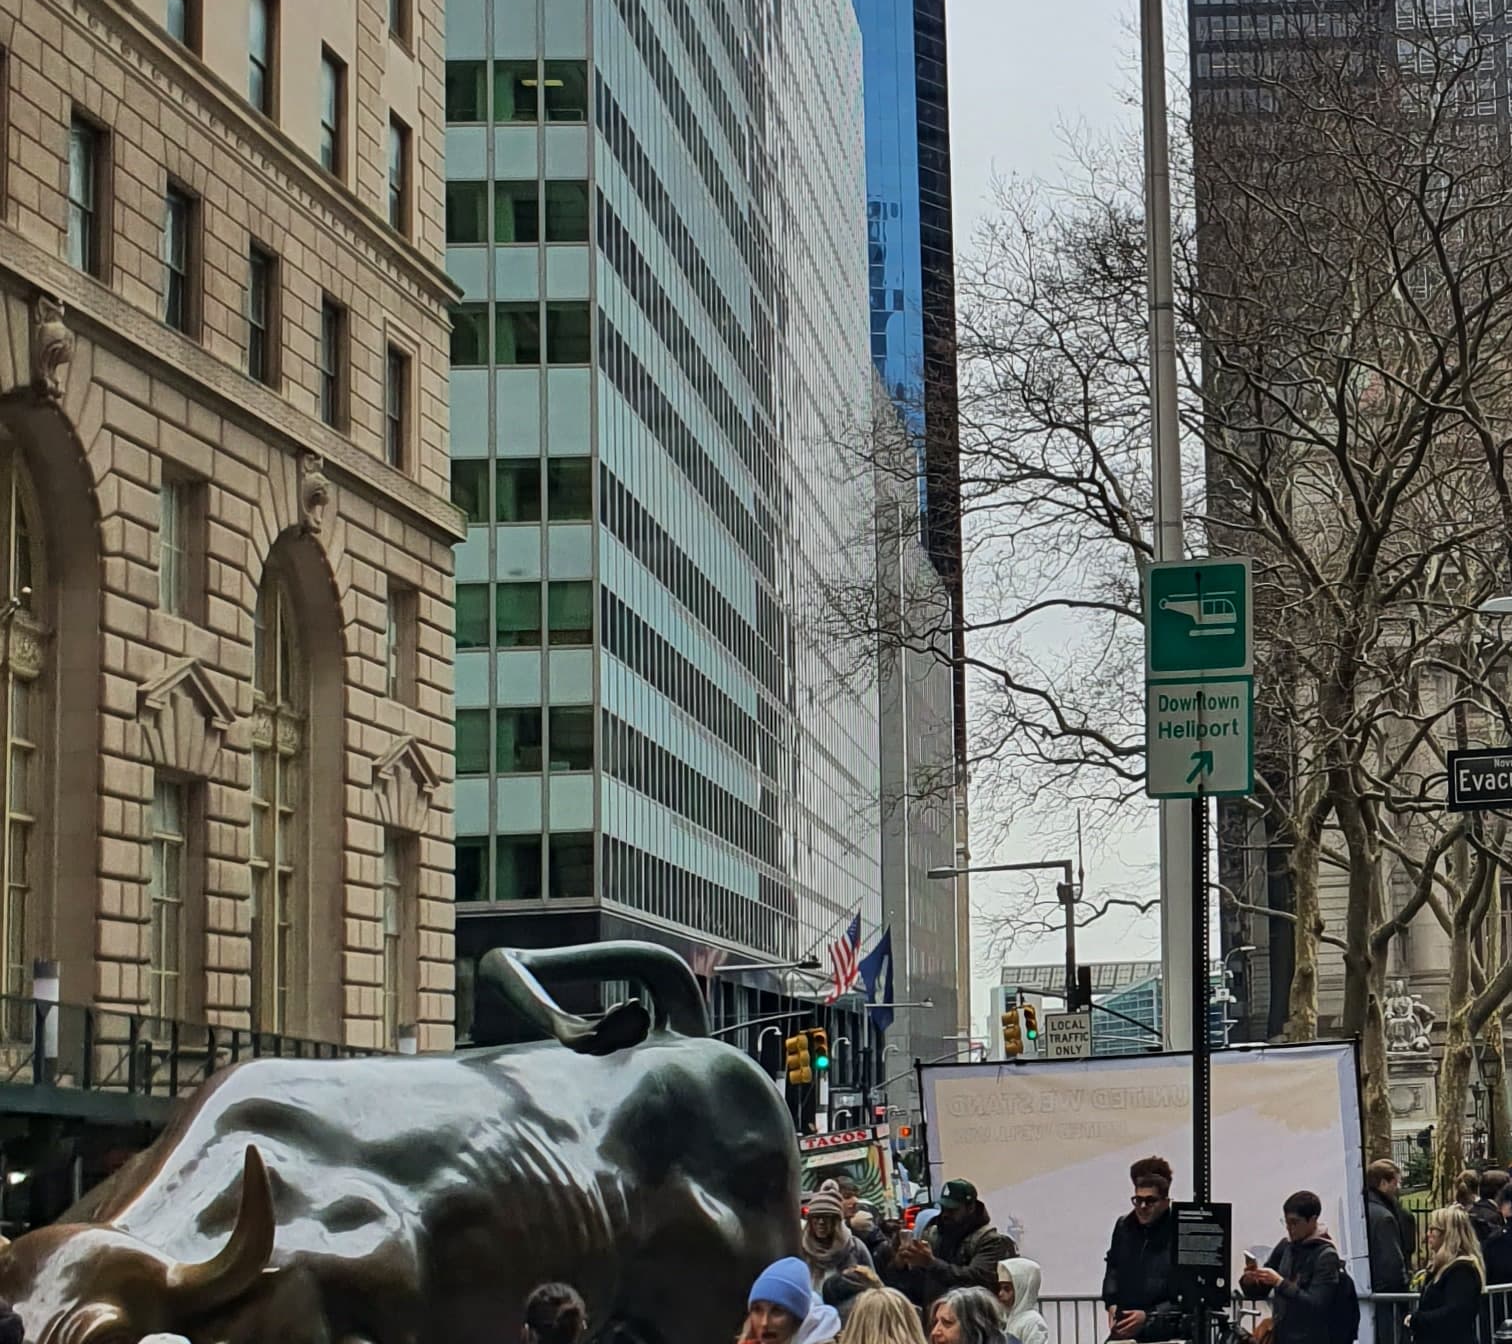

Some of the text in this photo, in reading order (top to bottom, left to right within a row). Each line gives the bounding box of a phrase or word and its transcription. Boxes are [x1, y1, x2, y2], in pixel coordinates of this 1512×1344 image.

[1158, 693, 1240, 713] Downtown
[1158, 718, 1239, 741] Heliport
[1050, 1020, 1086, 1031] LOCAL
[1049, 1032, 1089, 1043] TRAFFIC
[1055, 1045, 1082, 1056] ONLY
[805, 1130, 867, 1148] TACOS
